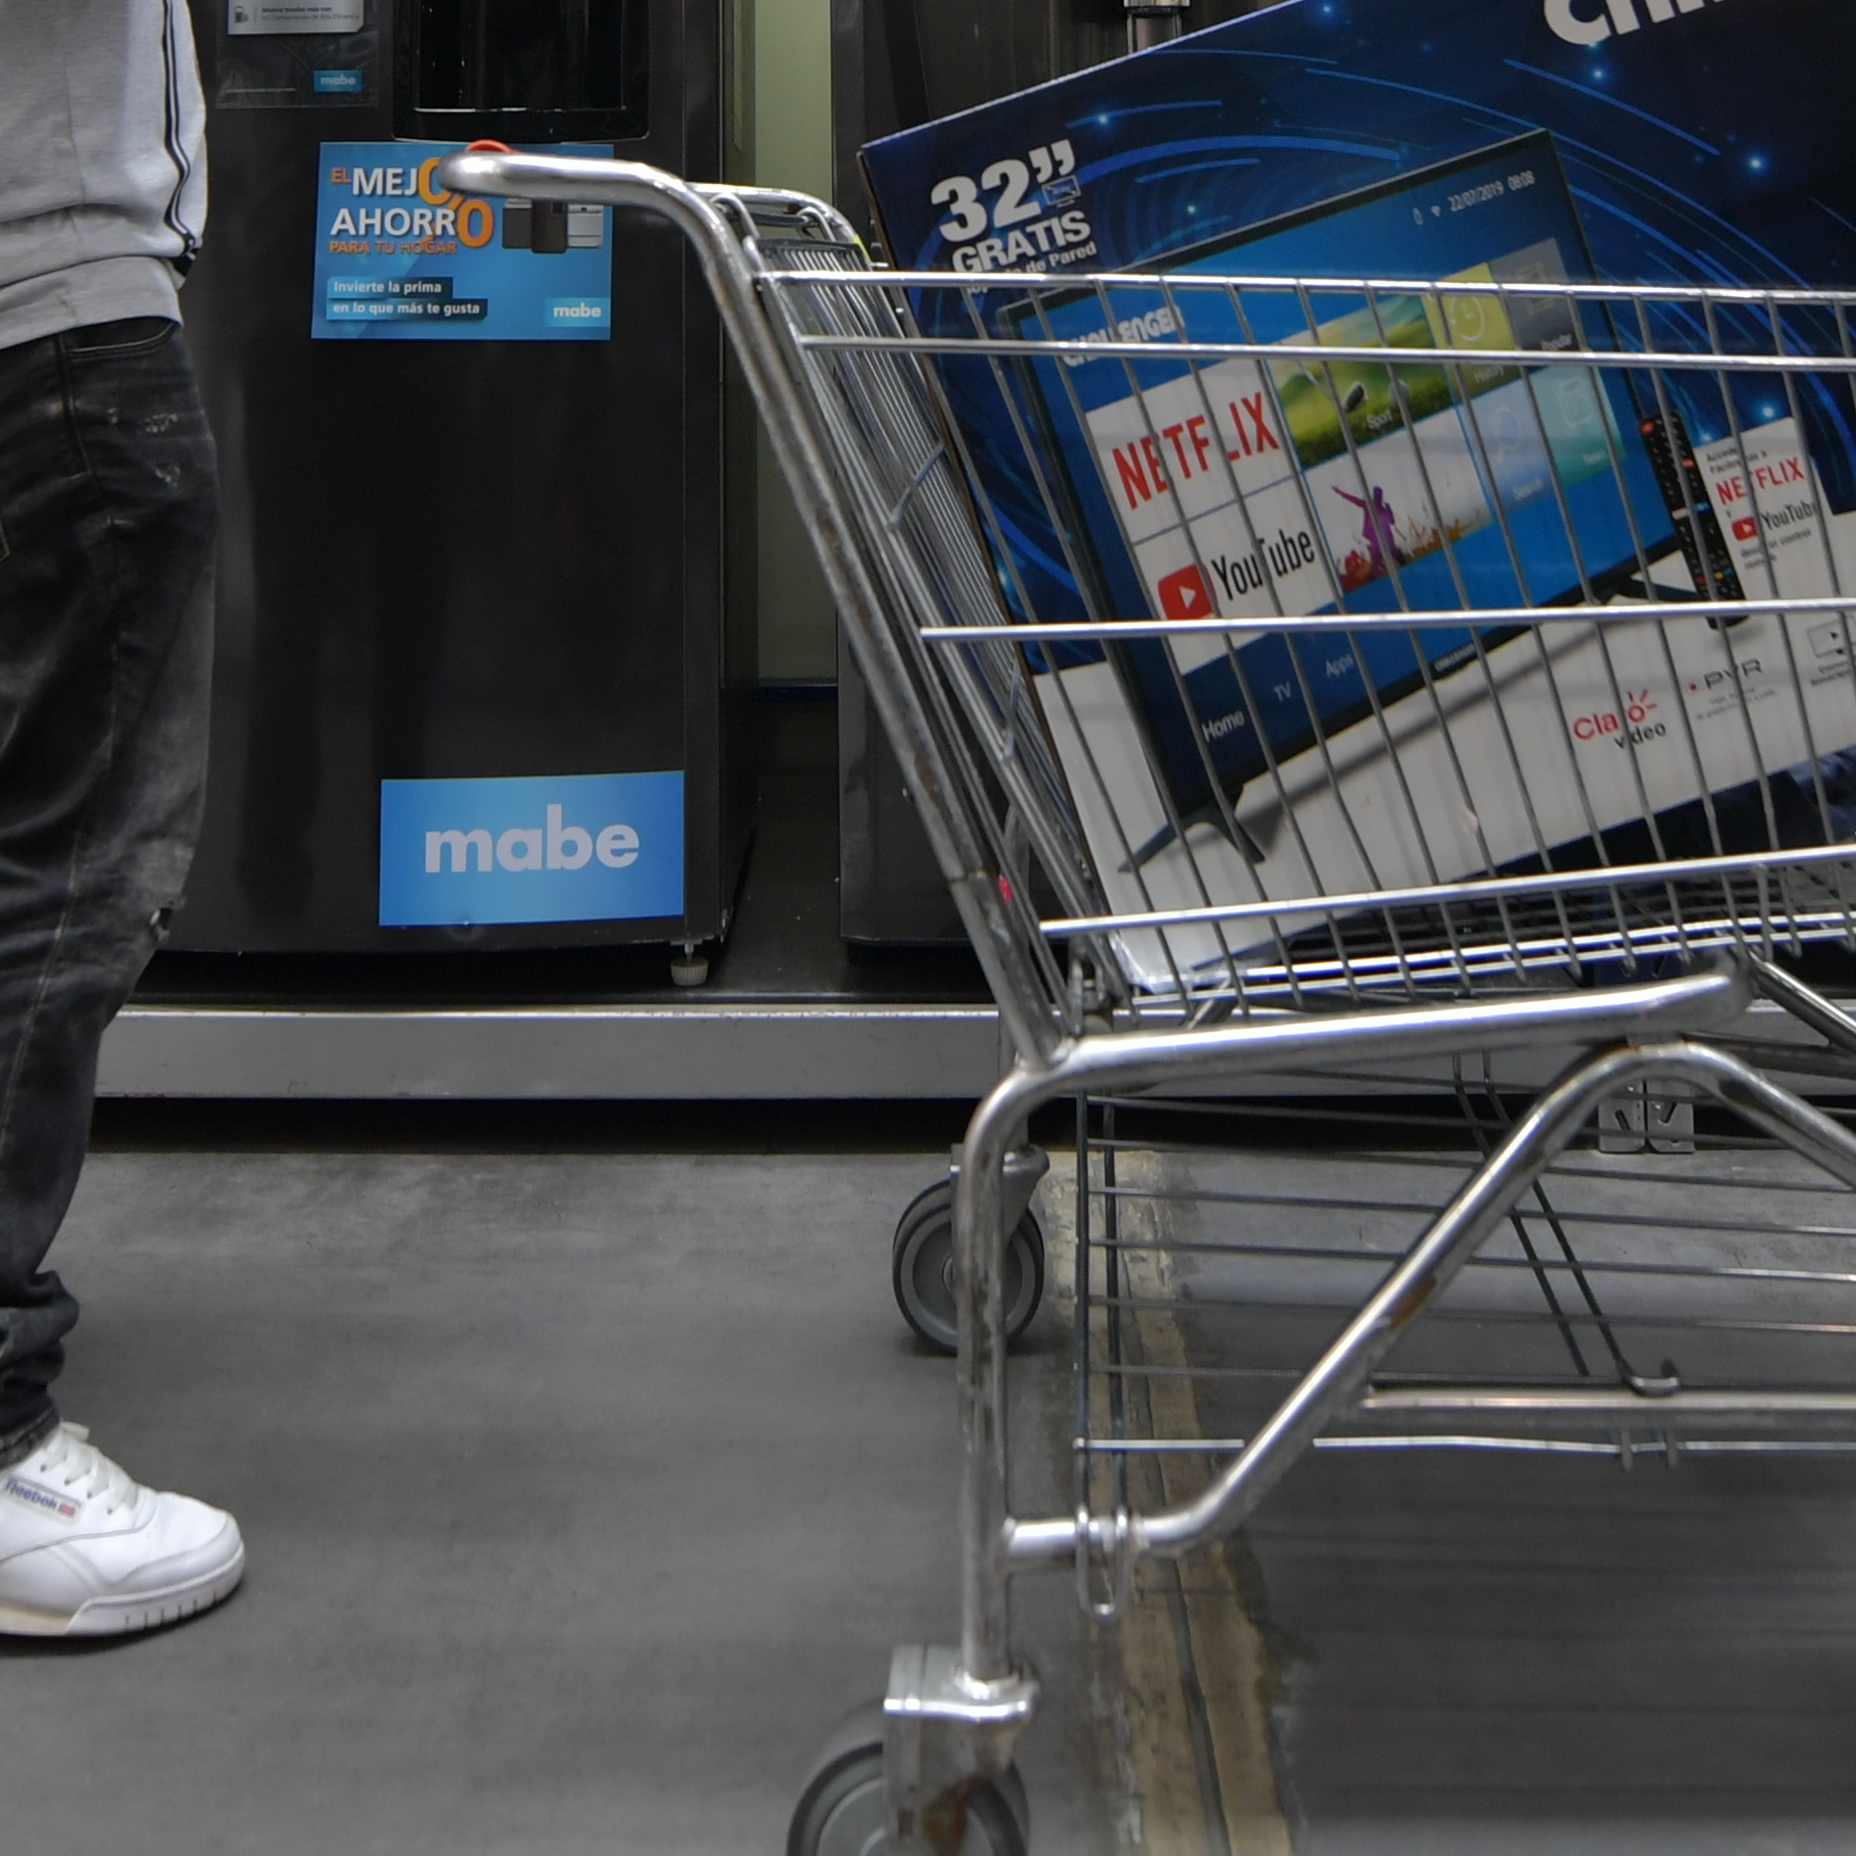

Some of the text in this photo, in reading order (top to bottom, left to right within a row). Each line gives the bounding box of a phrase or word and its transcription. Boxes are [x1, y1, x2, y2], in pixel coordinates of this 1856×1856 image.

[320, 74, 356, 86] mabe
[330, 166, 352, 185] EL
[329, 240, 457, 254] PARA TU HOGAR
[951, 209, 1092, 274] GRATIS
[1048, 240, 1098, 271] Pared
[333, 280, 442, 297] Invierte la prima
[332, 301, 480, 318] en lo que más te gusta
[552, 302, 602, 319] mabe
[1715, 456, 1806, 506] NEFLIX
[1324, 653, 1355, 679] Apps
[1272, 681, 1292, 703] TV
[1201, 709, 1245, 743] Home
[424, 803, 640, 873] mabe
[5, 1478, 58, 1512] Reebok
